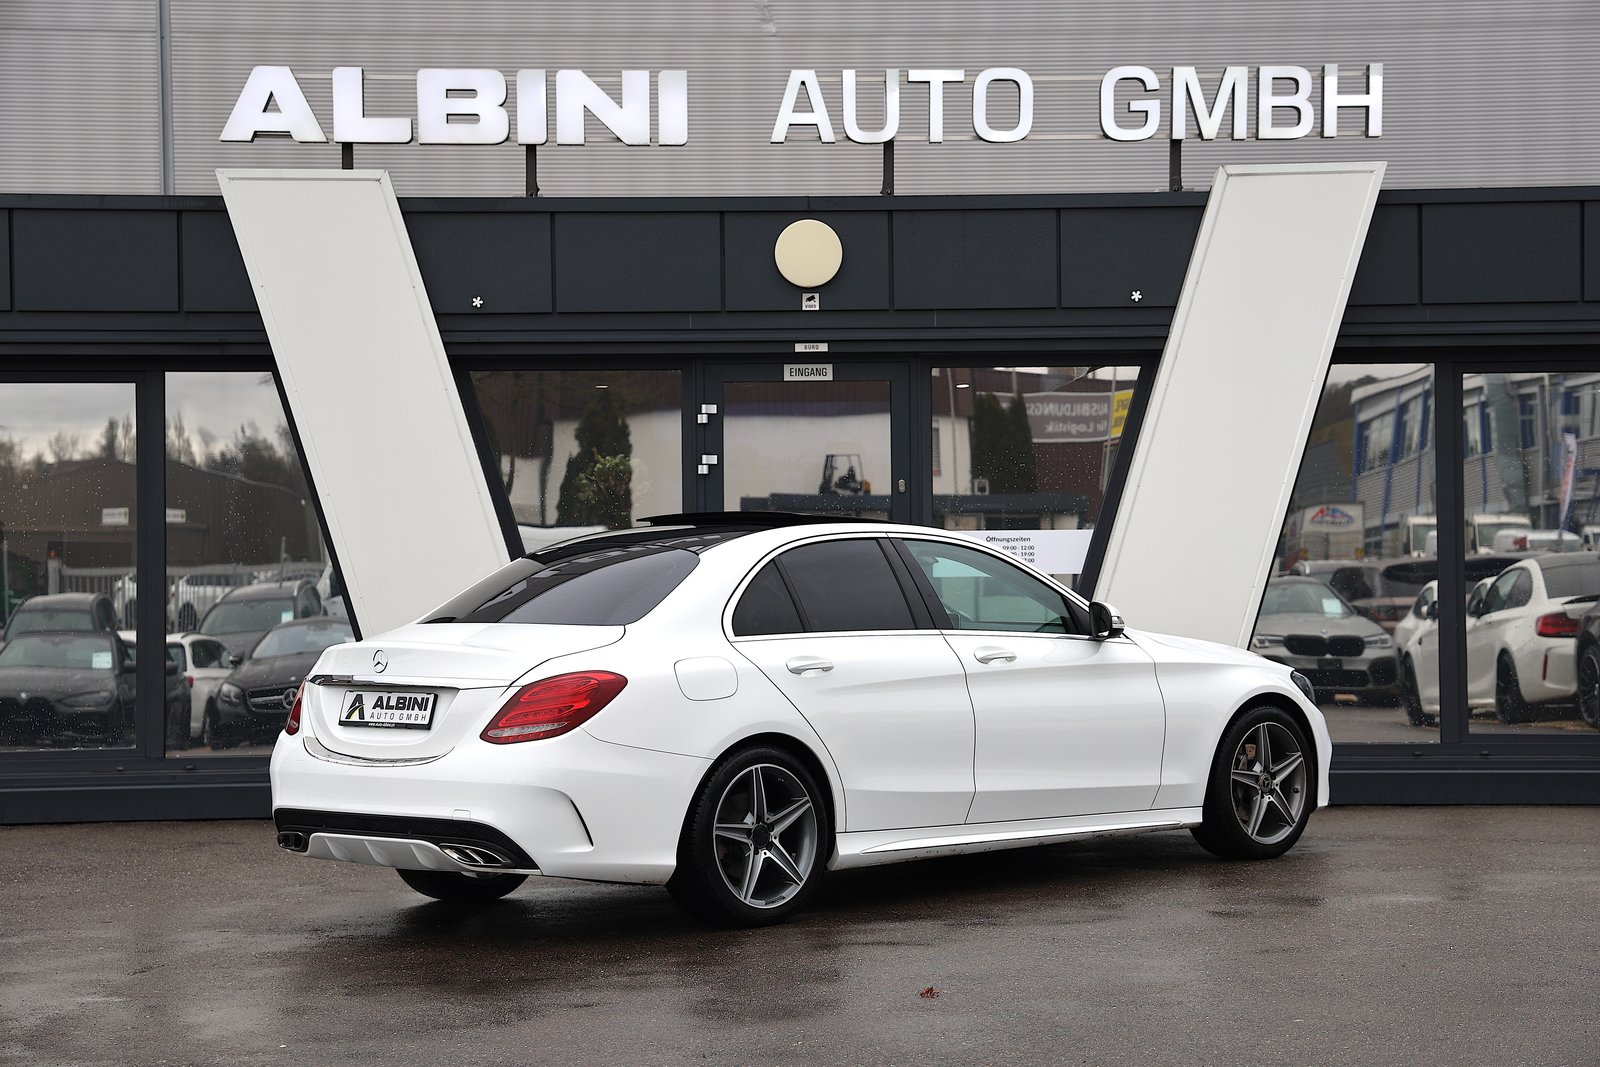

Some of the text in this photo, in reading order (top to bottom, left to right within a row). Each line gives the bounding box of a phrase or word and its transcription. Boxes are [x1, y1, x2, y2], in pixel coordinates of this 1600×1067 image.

[219, 62, 1384, 147] ALBINI AUTO GMBH
[789, 367, 828, 377] EINGANG
[372, 696, 430, 711] ALBINI
[370, 712, 427, 721] AUTO GMBH
